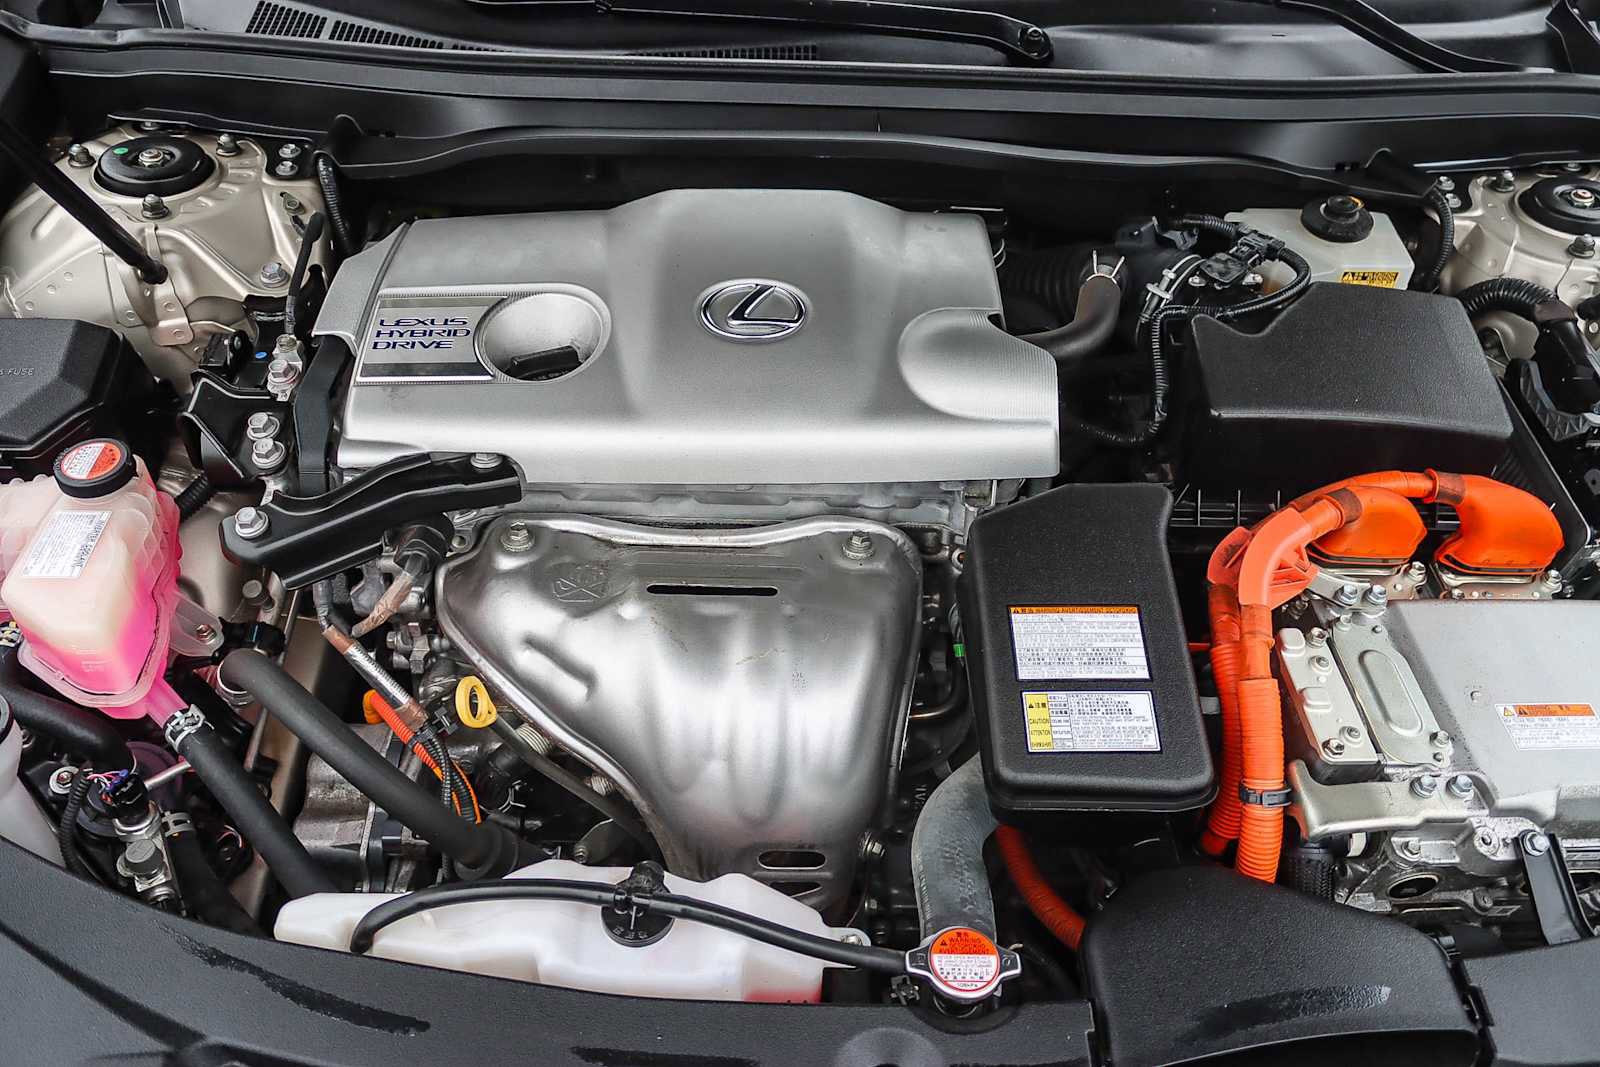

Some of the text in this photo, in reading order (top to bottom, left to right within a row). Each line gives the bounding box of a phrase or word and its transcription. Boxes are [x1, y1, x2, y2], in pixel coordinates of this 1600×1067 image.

[379, 318, 469, 327] LEXUS
[375, 328, 471, 338] HYBRID
[371, 340, 456, 350] DRIVE
[7, 367, 35, 377] FUSE
